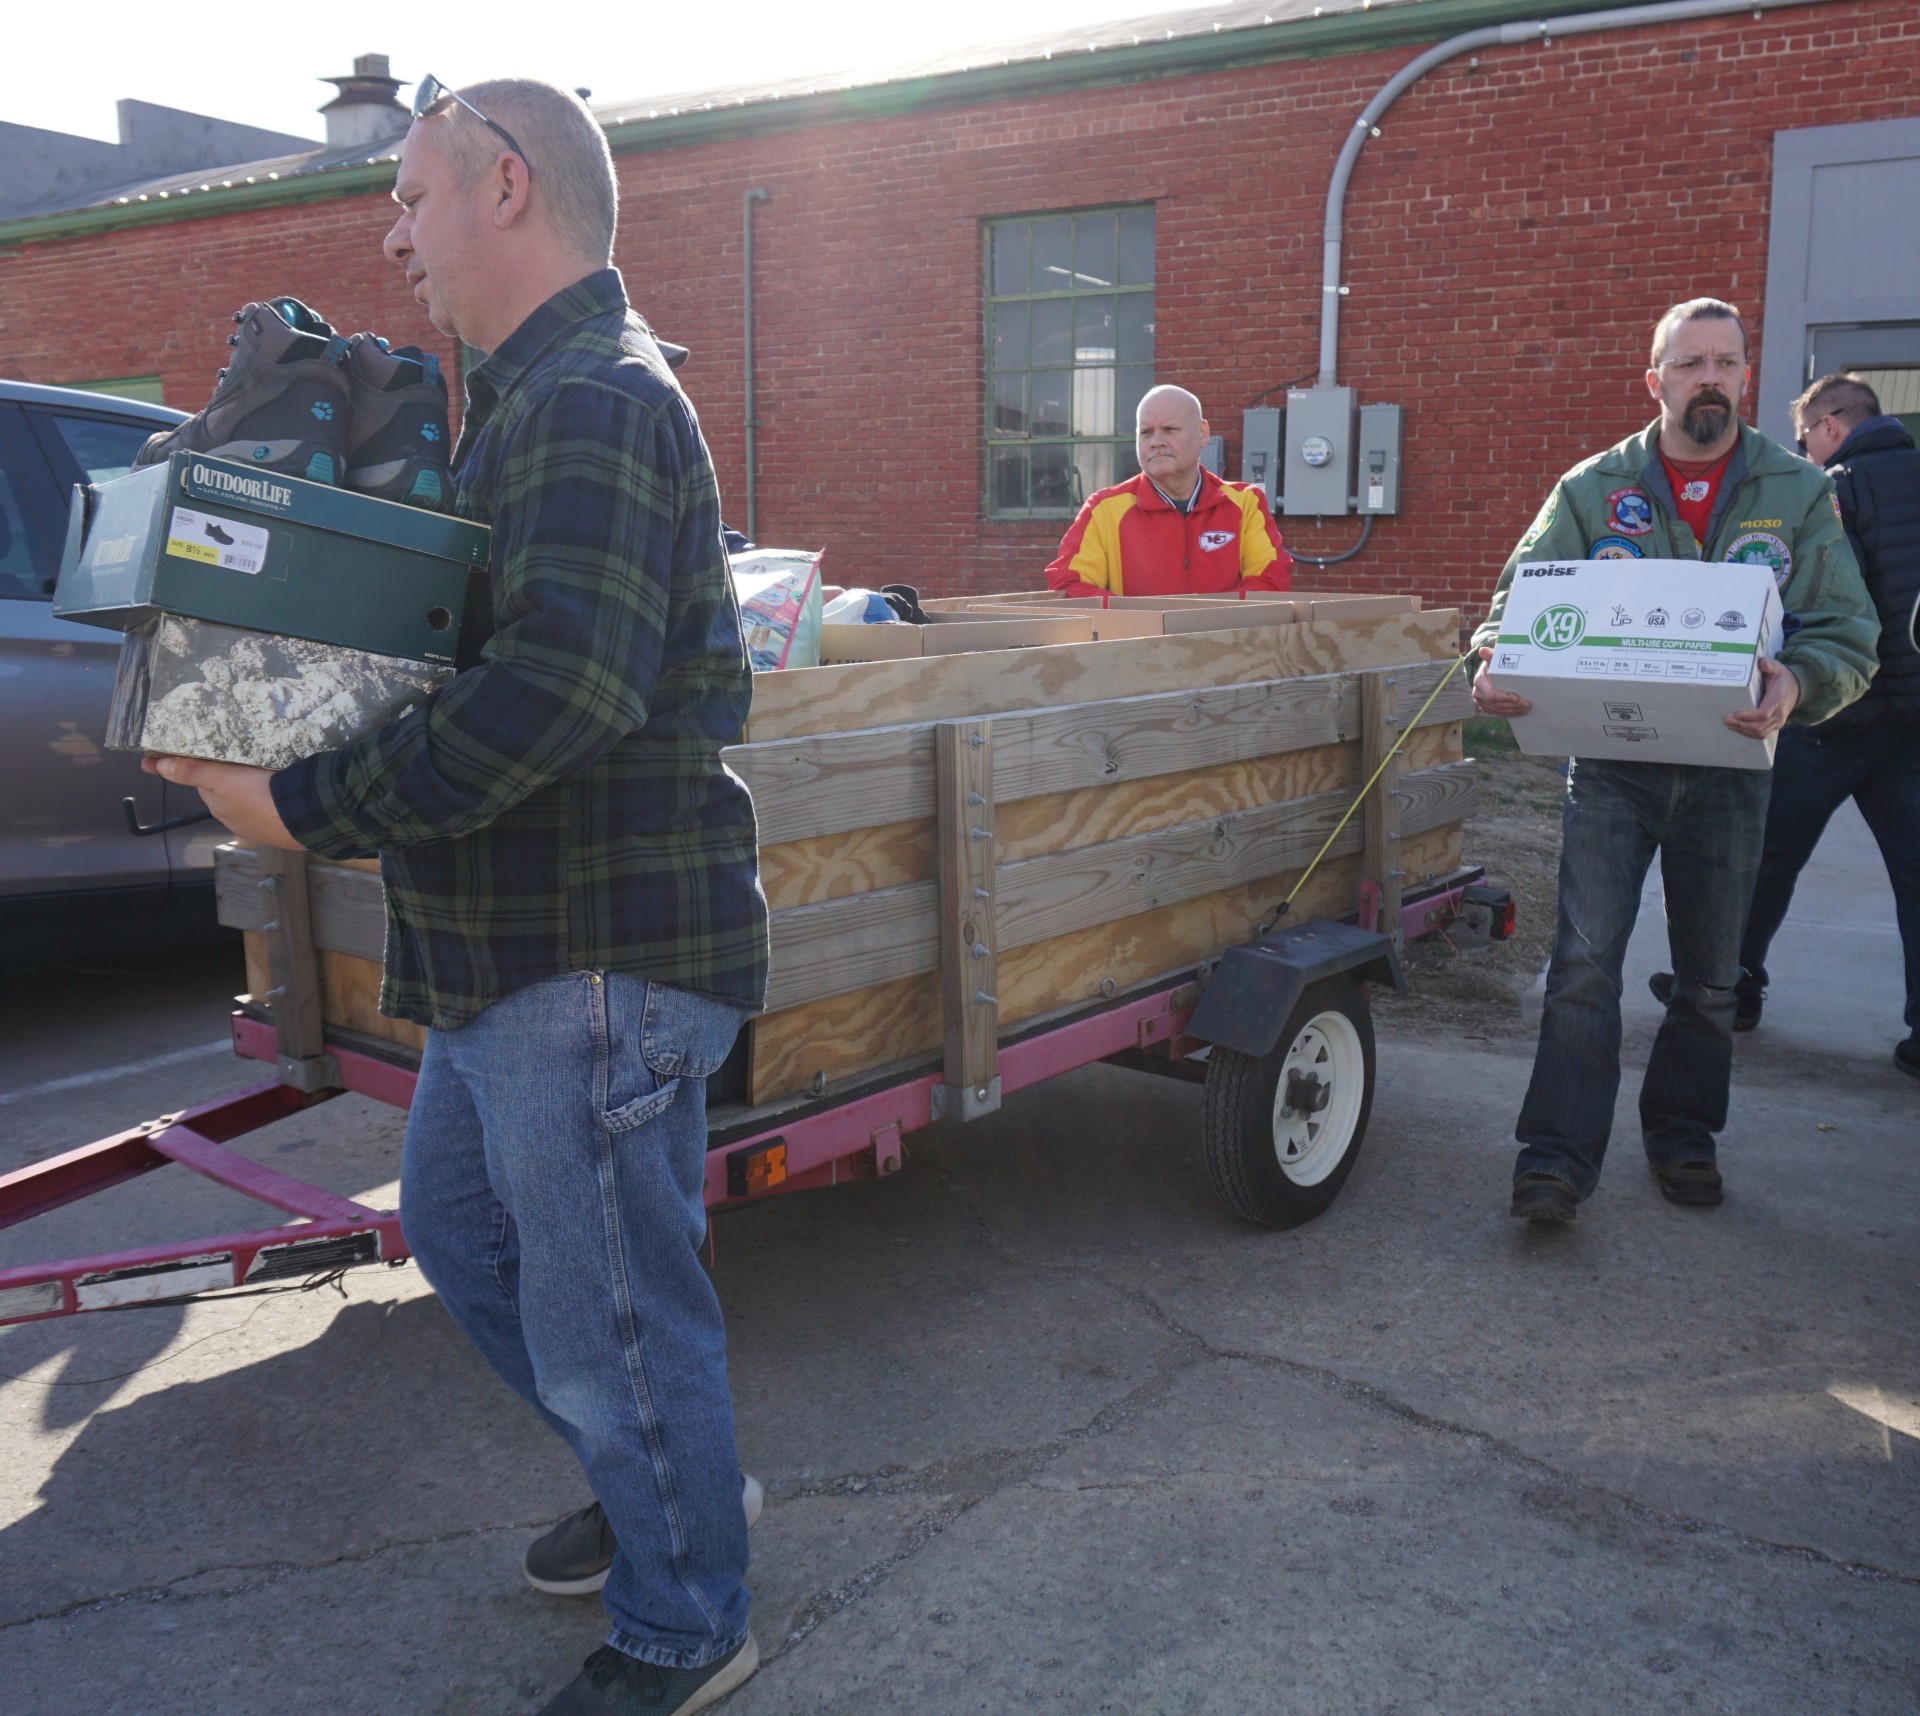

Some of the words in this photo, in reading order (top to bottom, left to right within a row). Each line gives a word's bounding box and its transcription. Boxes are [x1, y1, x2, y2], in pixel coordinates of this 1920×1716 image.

[1522, 564, 1577, 577] BOISE
[1647, 617, 1666, 626] USA
[1621, 638, 1661, 648] MULTI-USE
[1662, 640, 1685, 650] COPY
[1685, 641, 1712, 650] PAPER
